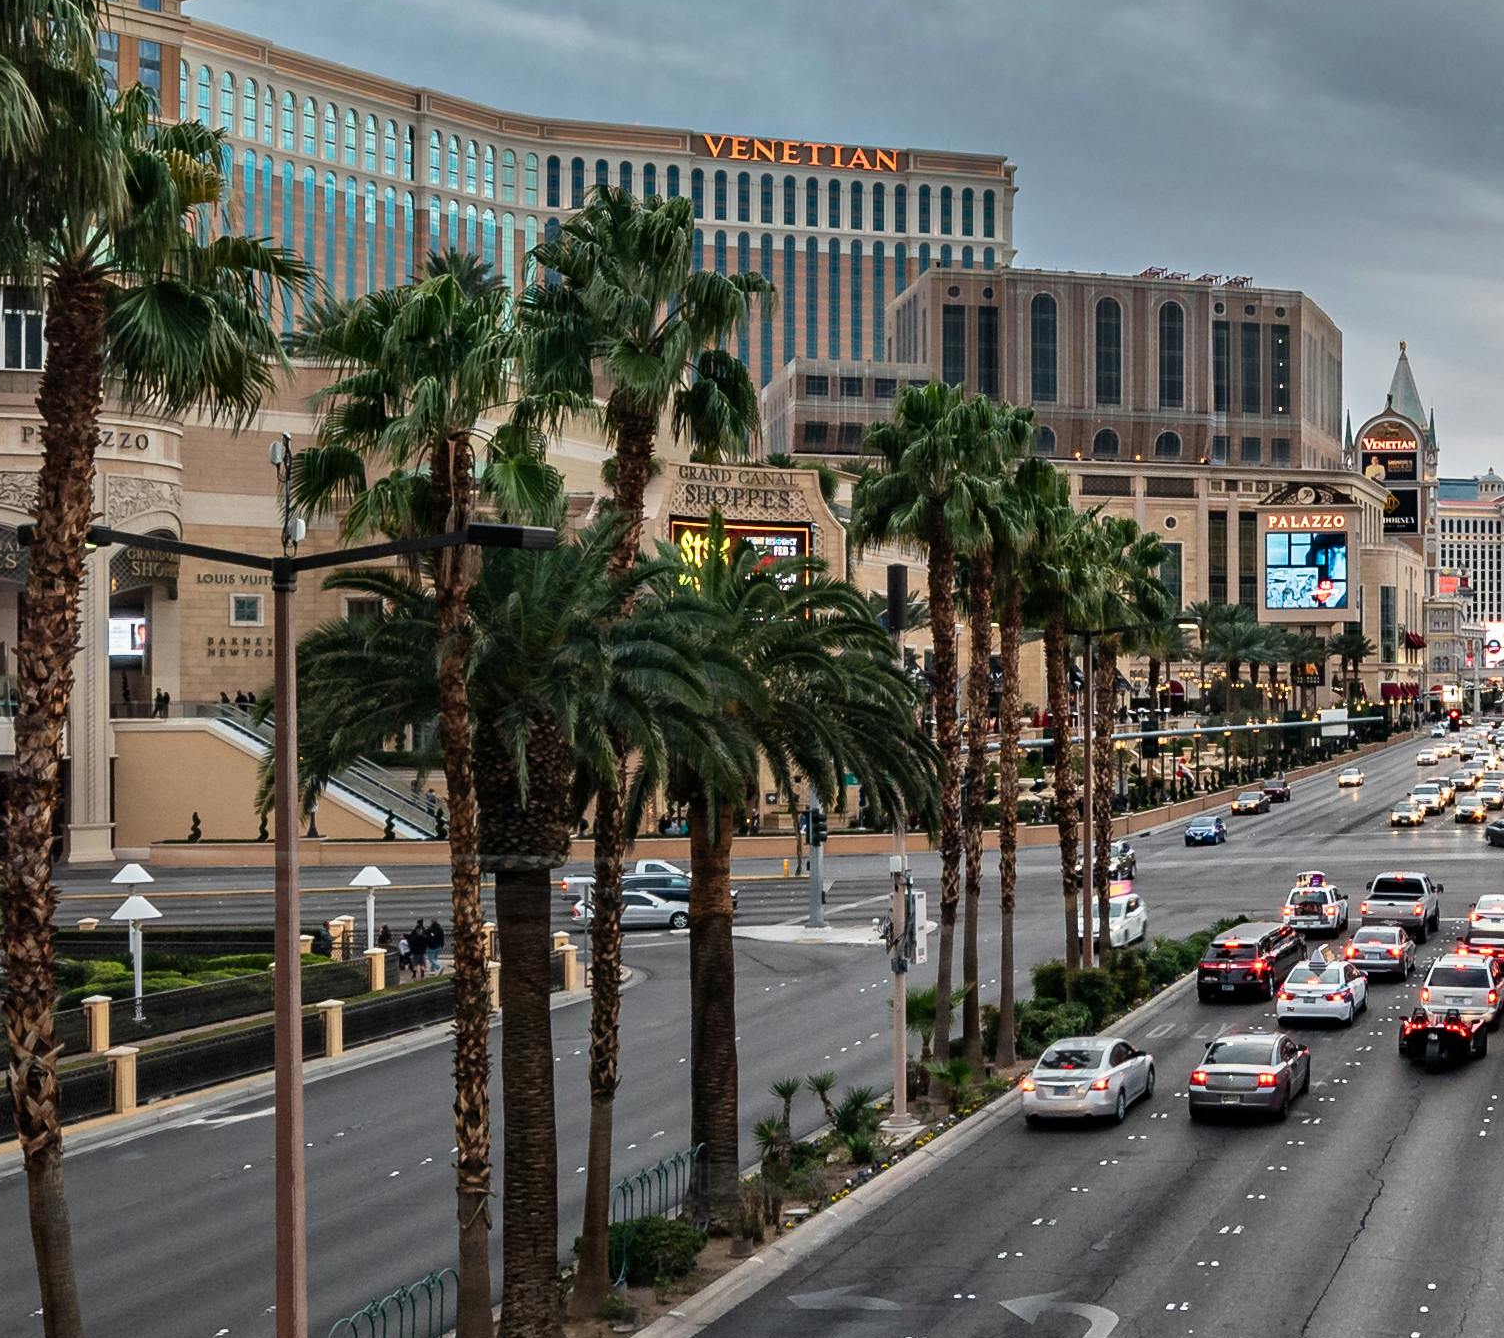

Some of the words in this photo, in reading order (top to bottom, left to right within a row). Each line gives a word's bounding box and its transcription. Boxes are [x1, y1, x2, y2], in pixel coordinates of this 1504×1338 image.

[703, 133, 899, 172] VENETIAN
[22, 426, 149, 450] PZZO
[1363, 438, 1417, 450] VENETIAN
[679, 465, 732, 483] GRAND
[739, 472, 799, 486] CANAL
[686, 484, 790, 509] SHOPPES
[1268, 514, 1345, 529] PALAZZO
[197, 573, 235, 585] LOUIS
[208, 637, 273, 647] BARNEY
